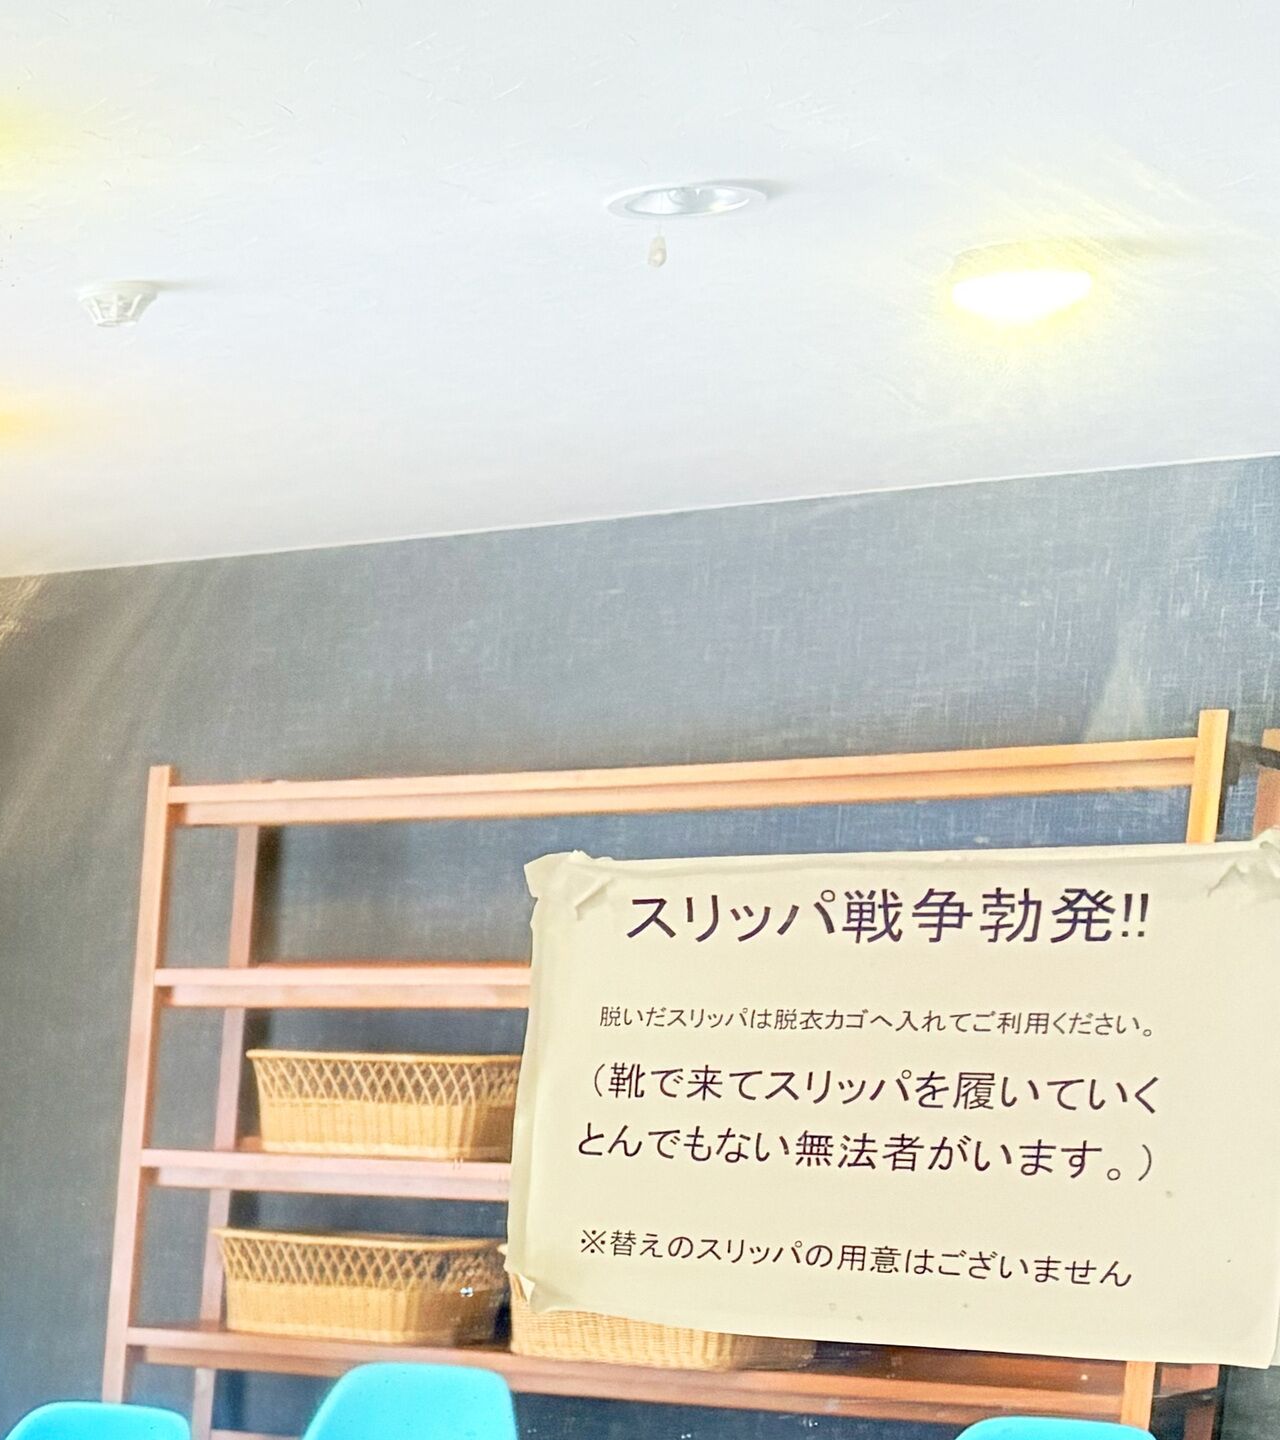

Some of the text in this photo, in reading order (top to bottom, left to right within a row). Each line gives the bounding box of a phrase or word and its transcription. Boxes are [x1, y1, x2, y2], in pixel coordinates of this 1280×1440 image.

[626, 887, 1150, 944] スリッパ戦争勃発!!
[599, 1005, 1153, 1038] 脱いだスリッパは脱衣カゴへ入れてご利用ください。
[580, 1229, 1133, 1288] ※替えのスリッパの用意はございません
